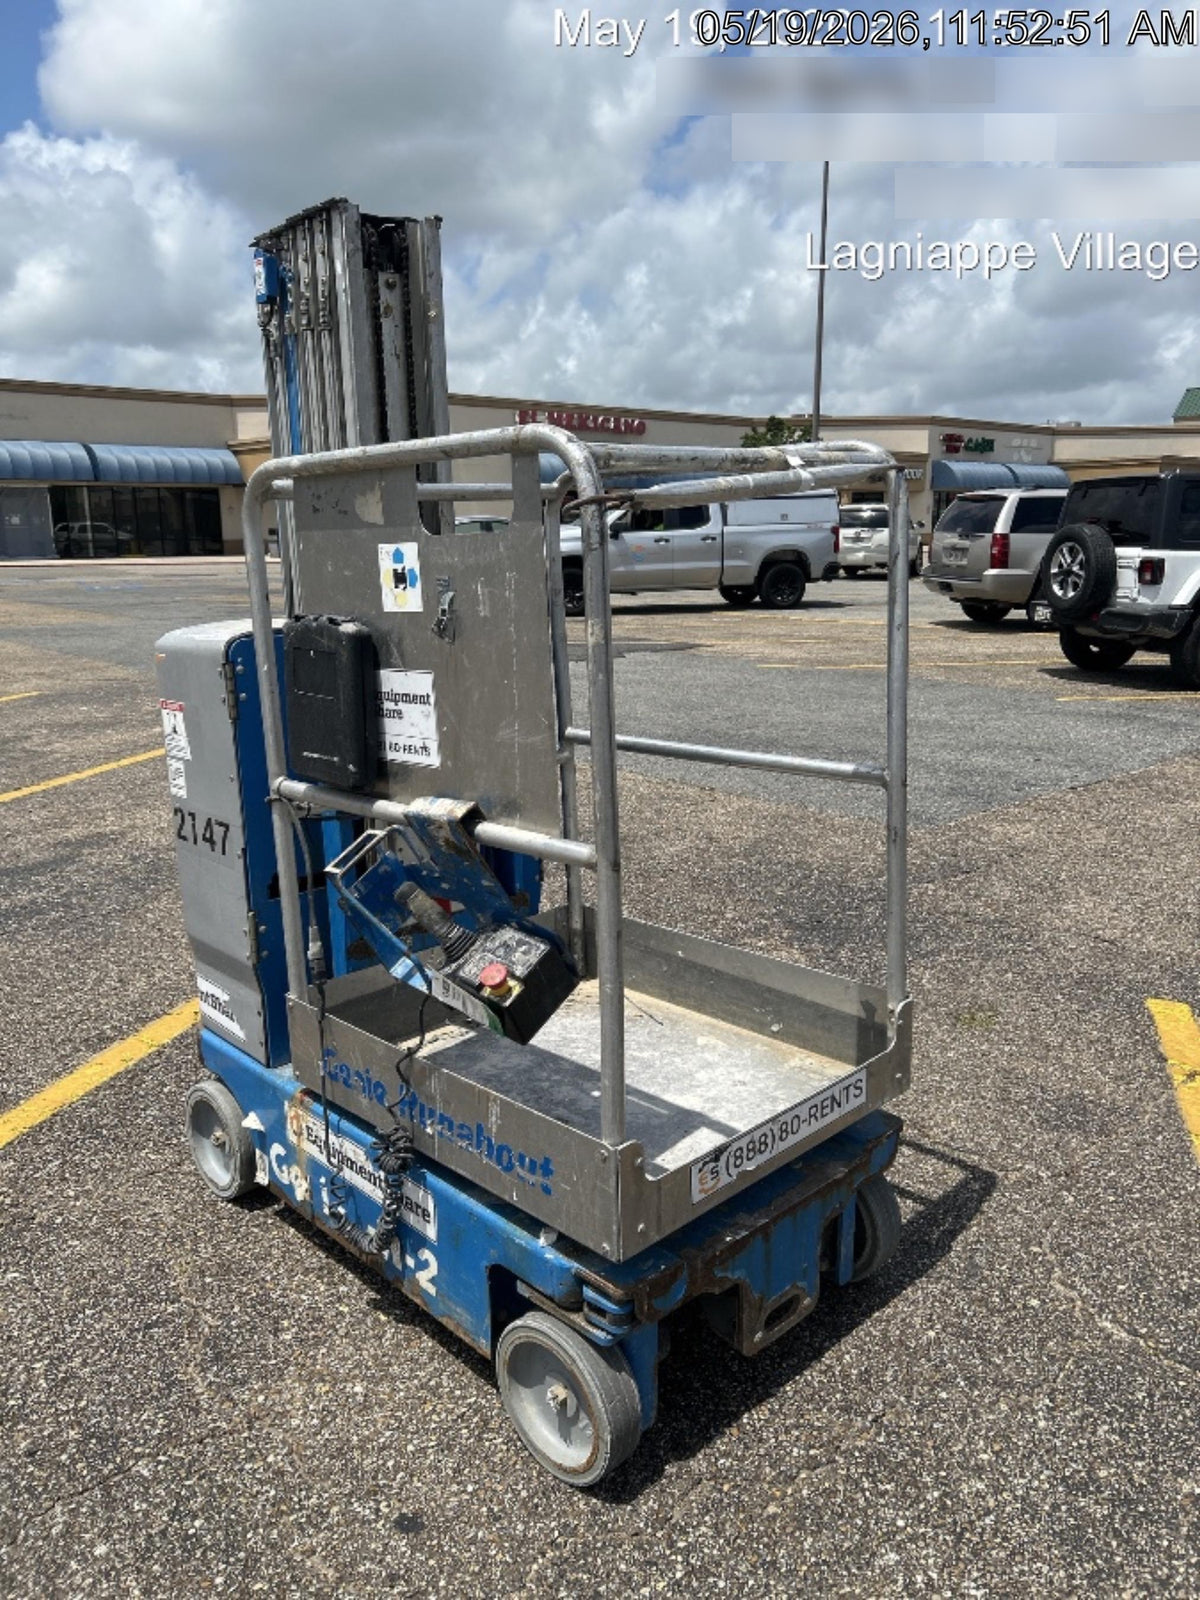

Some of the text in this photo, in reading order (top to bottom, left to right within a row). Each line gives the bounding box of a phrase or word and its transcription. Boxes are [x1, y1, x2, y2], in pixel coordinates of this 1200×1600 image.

[377, 688, 432, 707] quipment
[378, 704, 404, 720] hare
[173, 806, 230, 856] 2147
[725, 1078, 864, 1177] (888)80-RENTS
